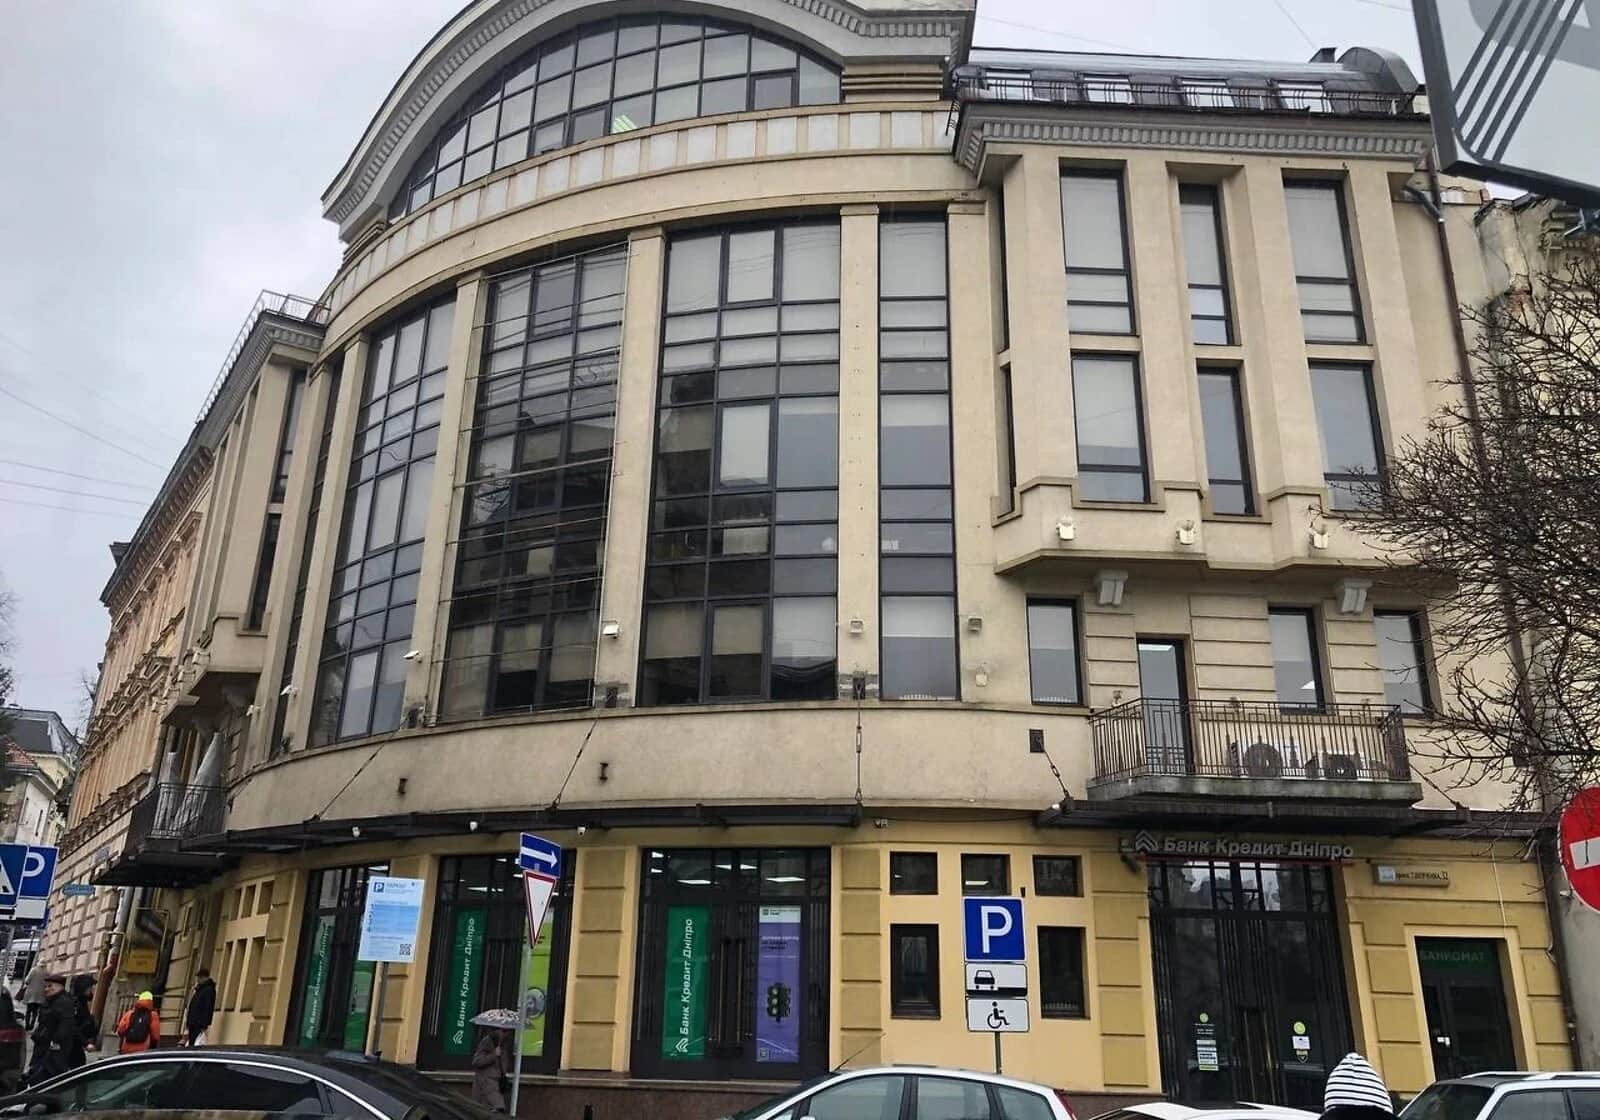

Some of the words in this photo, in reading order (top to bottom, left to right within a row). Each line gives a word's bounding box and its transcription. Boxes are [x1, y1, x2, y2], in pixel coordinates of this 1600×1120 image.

[1164, 838, 1210, 853] Банк
[1215, 839, 1283, 856] Кредит
[1288, 841, 1354, 860] Дніпро
[465, 917, 475, 956] Дніпро
[683, 918, 695, 959] Дніпро
[981, 905, 1013, 954] P
[1419, 950, 1484, 961] БАНКОМАТ
[460, 958, 471, 997] Кредит
[681, 960, 692, 1003] Кредит
[457, 1000, 467, 1027] Банк
[680, 1005, 689, 1035] Банк
